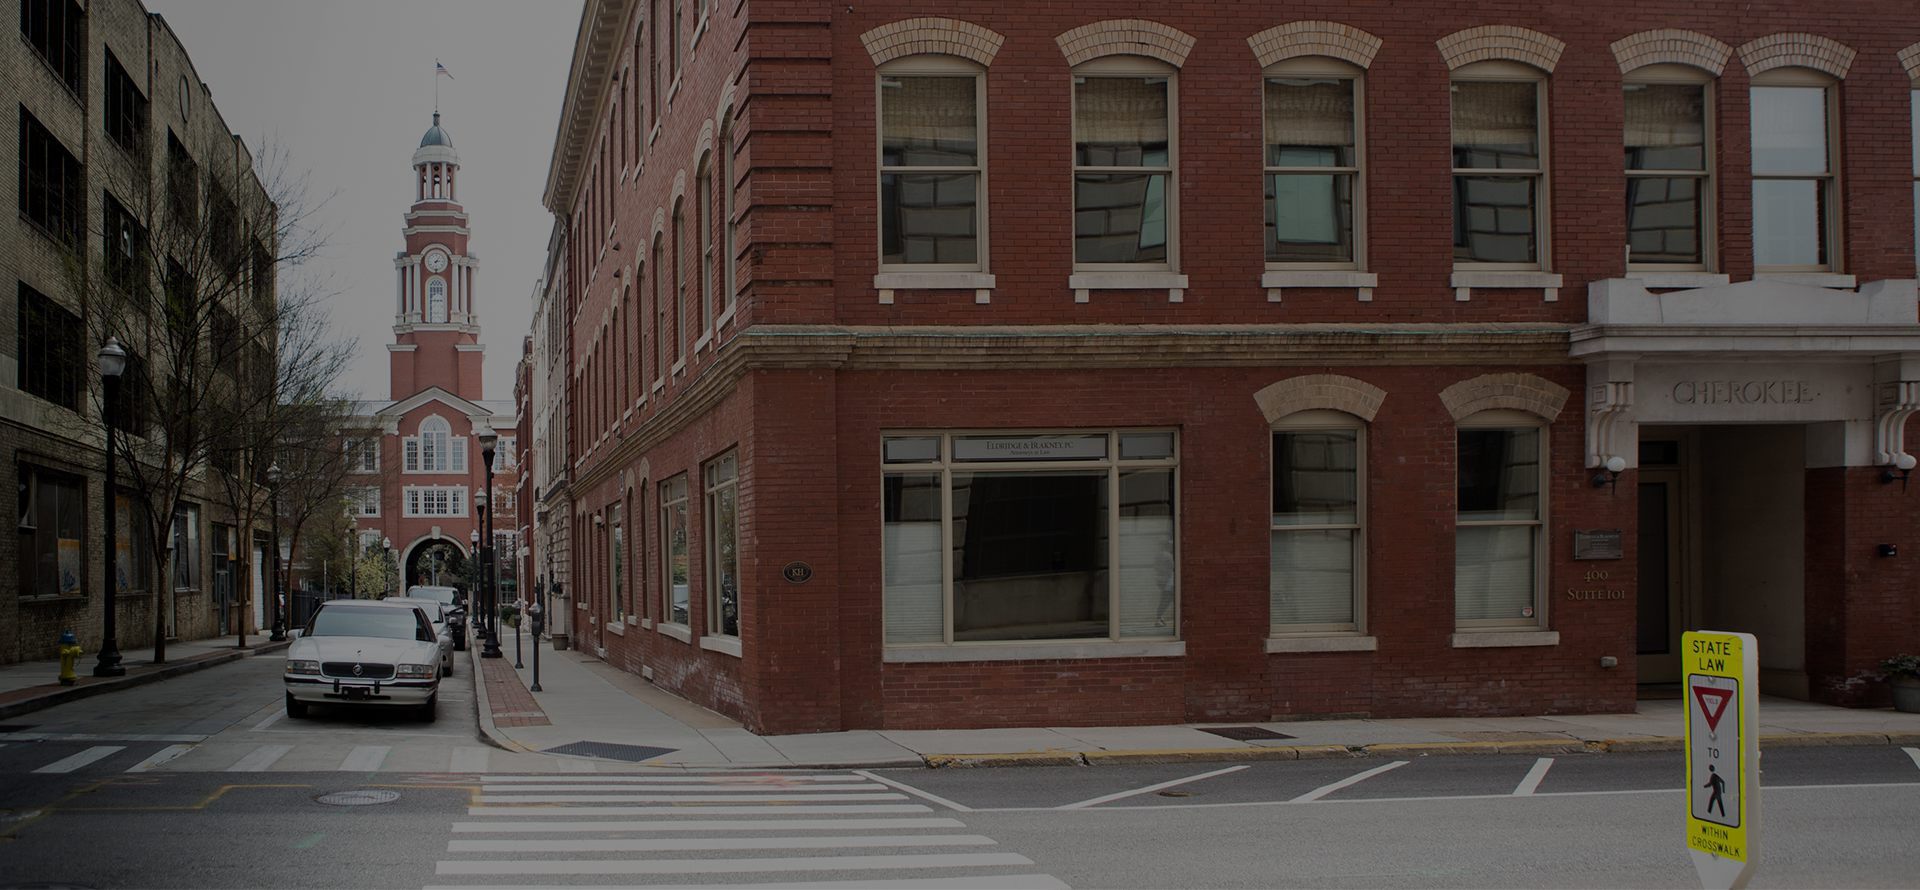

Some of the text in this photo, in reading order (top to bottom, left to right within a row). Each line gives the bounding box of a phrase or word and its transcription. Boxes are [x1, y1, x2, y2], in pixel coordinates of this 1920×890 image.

[1672, 380, 1814, 404] CHEROKEE
[1584, 570, 1608, 583] 400
[1692, 640, 1731, 656] STATE
[1699, 657, 1725, 672] LAW
[1708, 747, 1719, 759] TO
[1701, 824, 1728, 840] WITHIN
[1692, 836, 1740, 857] CROSSWALK
